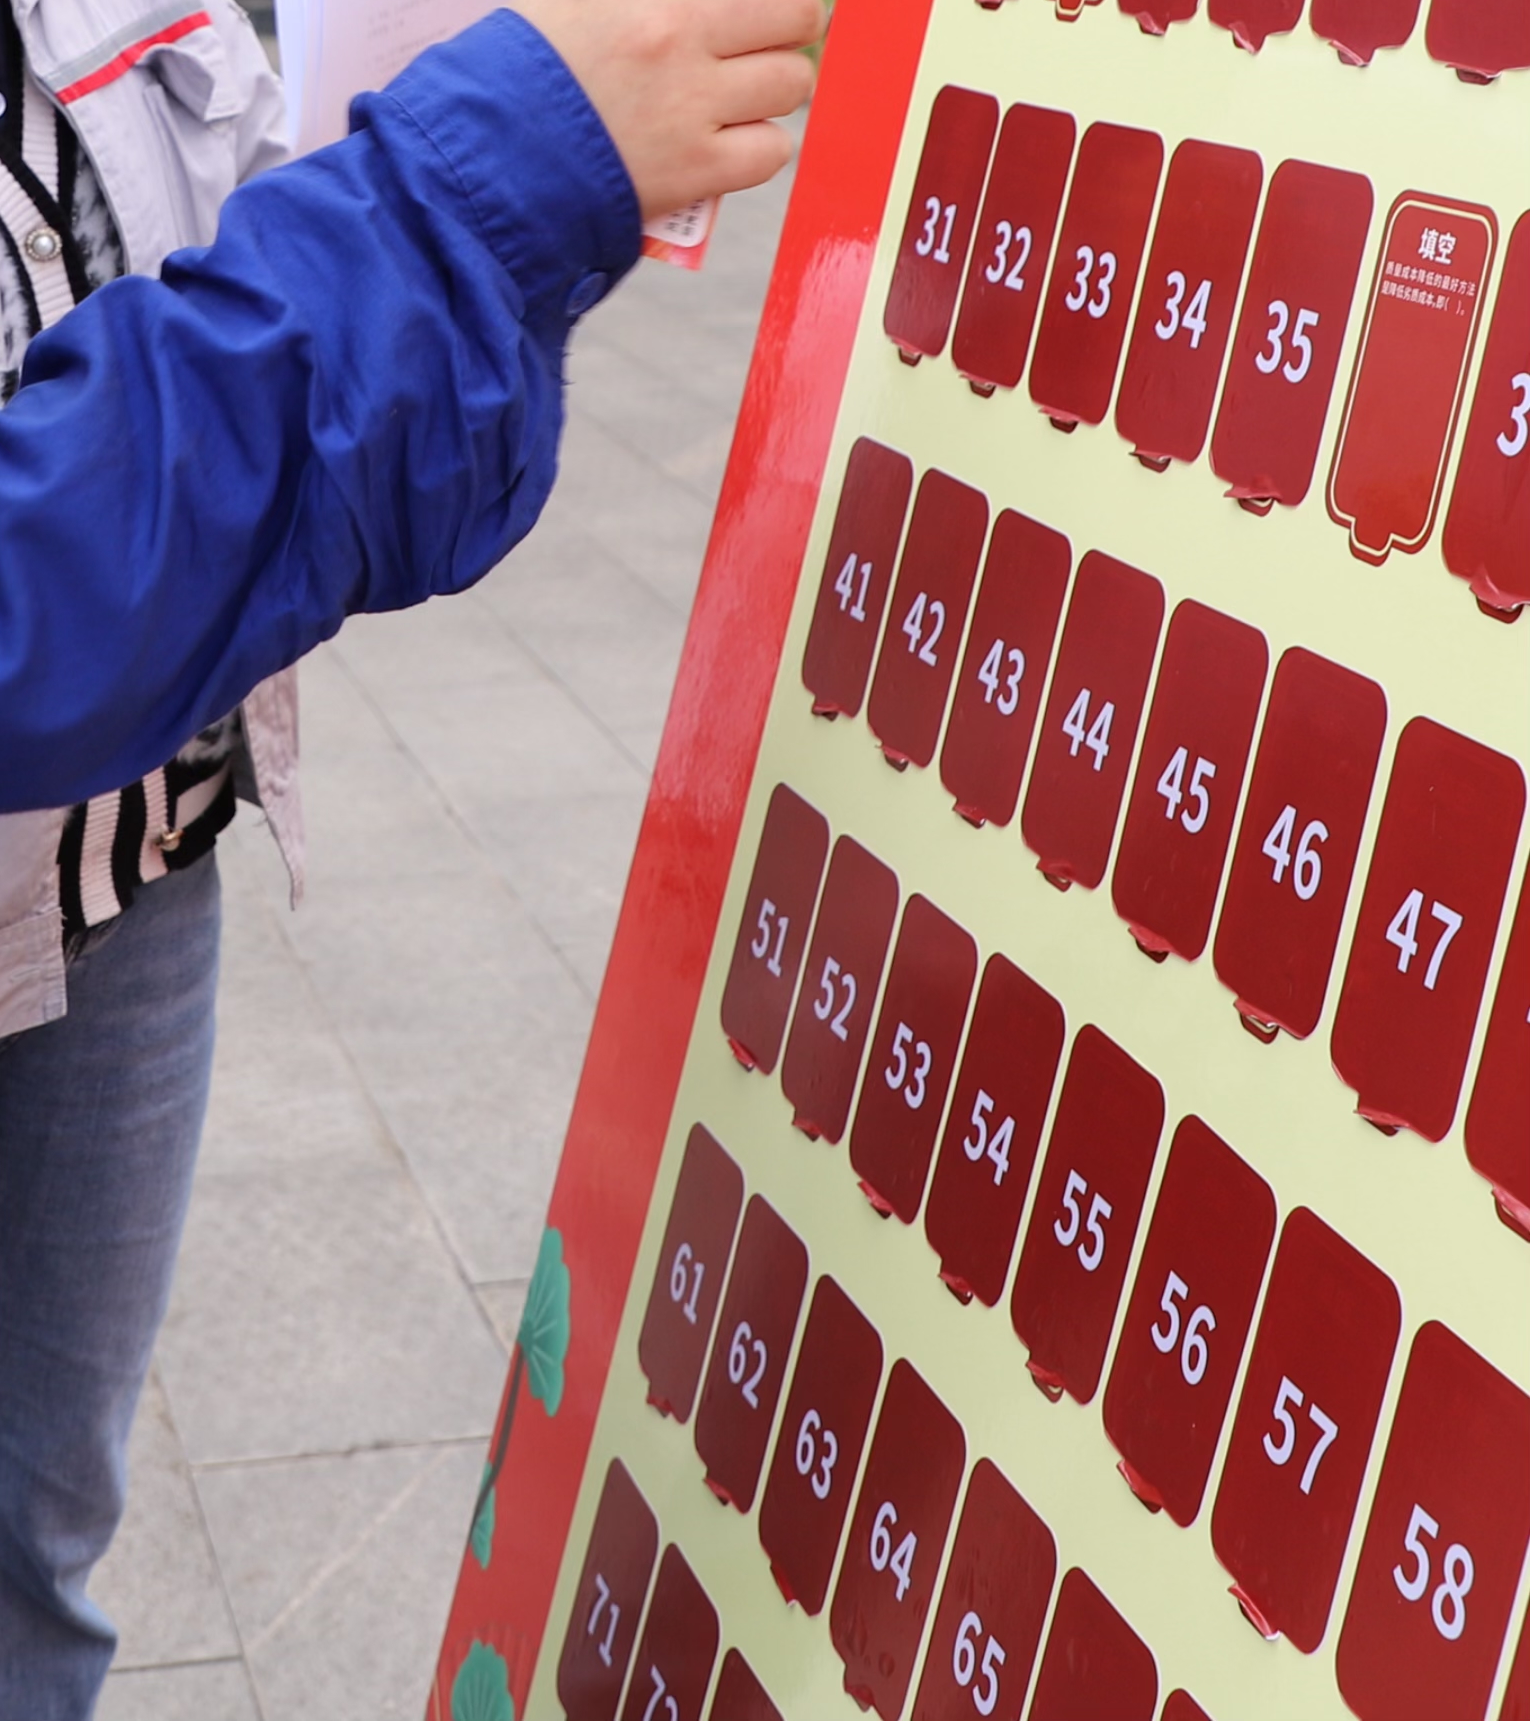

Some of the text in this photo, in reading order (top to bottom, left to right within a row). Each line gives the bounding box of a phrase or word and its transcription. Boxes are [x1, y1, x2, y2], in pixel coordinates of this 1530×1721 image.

[915, 197, 956, 263] 31
[985, 221, 1032, 291] 32
[1418, 227, 1456, 265] 填空
[1065, 246, 1117, 318] 33
[1155, 271, 1212, 349] 34
[1385, 261, 1476, 297] 质量成本降低的最好方法
[1255, 301, 1319, 383] 35
[1496, 373, 1530, 457] 3
[835, 553, 872, 621] 41
[902, 593, 945, 666] 42
[977, 639, 1025, 715] 43
[1062, 689, 1114, 771] 44
[1156, 747, 1216, 833] 45
[1262, 806, 1328, 900] 46
[751, 899, 789, 976] 51
[1386, 890, 1462, 989] 47
[813, 957, 856, 1041] 52
[885, 1022, 932, 1109] 53
[963, 1090, 1015, 1185] 54
[1054, 1171, 1112, 1272] 55
[670, 1243, 705, 1324] 61
[728, 1321, 767, 1408] 62
[1151, 1272, 1216, 1385] 56
[796, 1409, 838, 1500] 63
[1263, 1378, 1338, 1493] 57
[870, 1501, 917, 1600] 64
[1393, 1505, 1474, 1640] 58
[587, 1574, 620, 1667] 71
[953, 1611, 1006, 1716] 65
